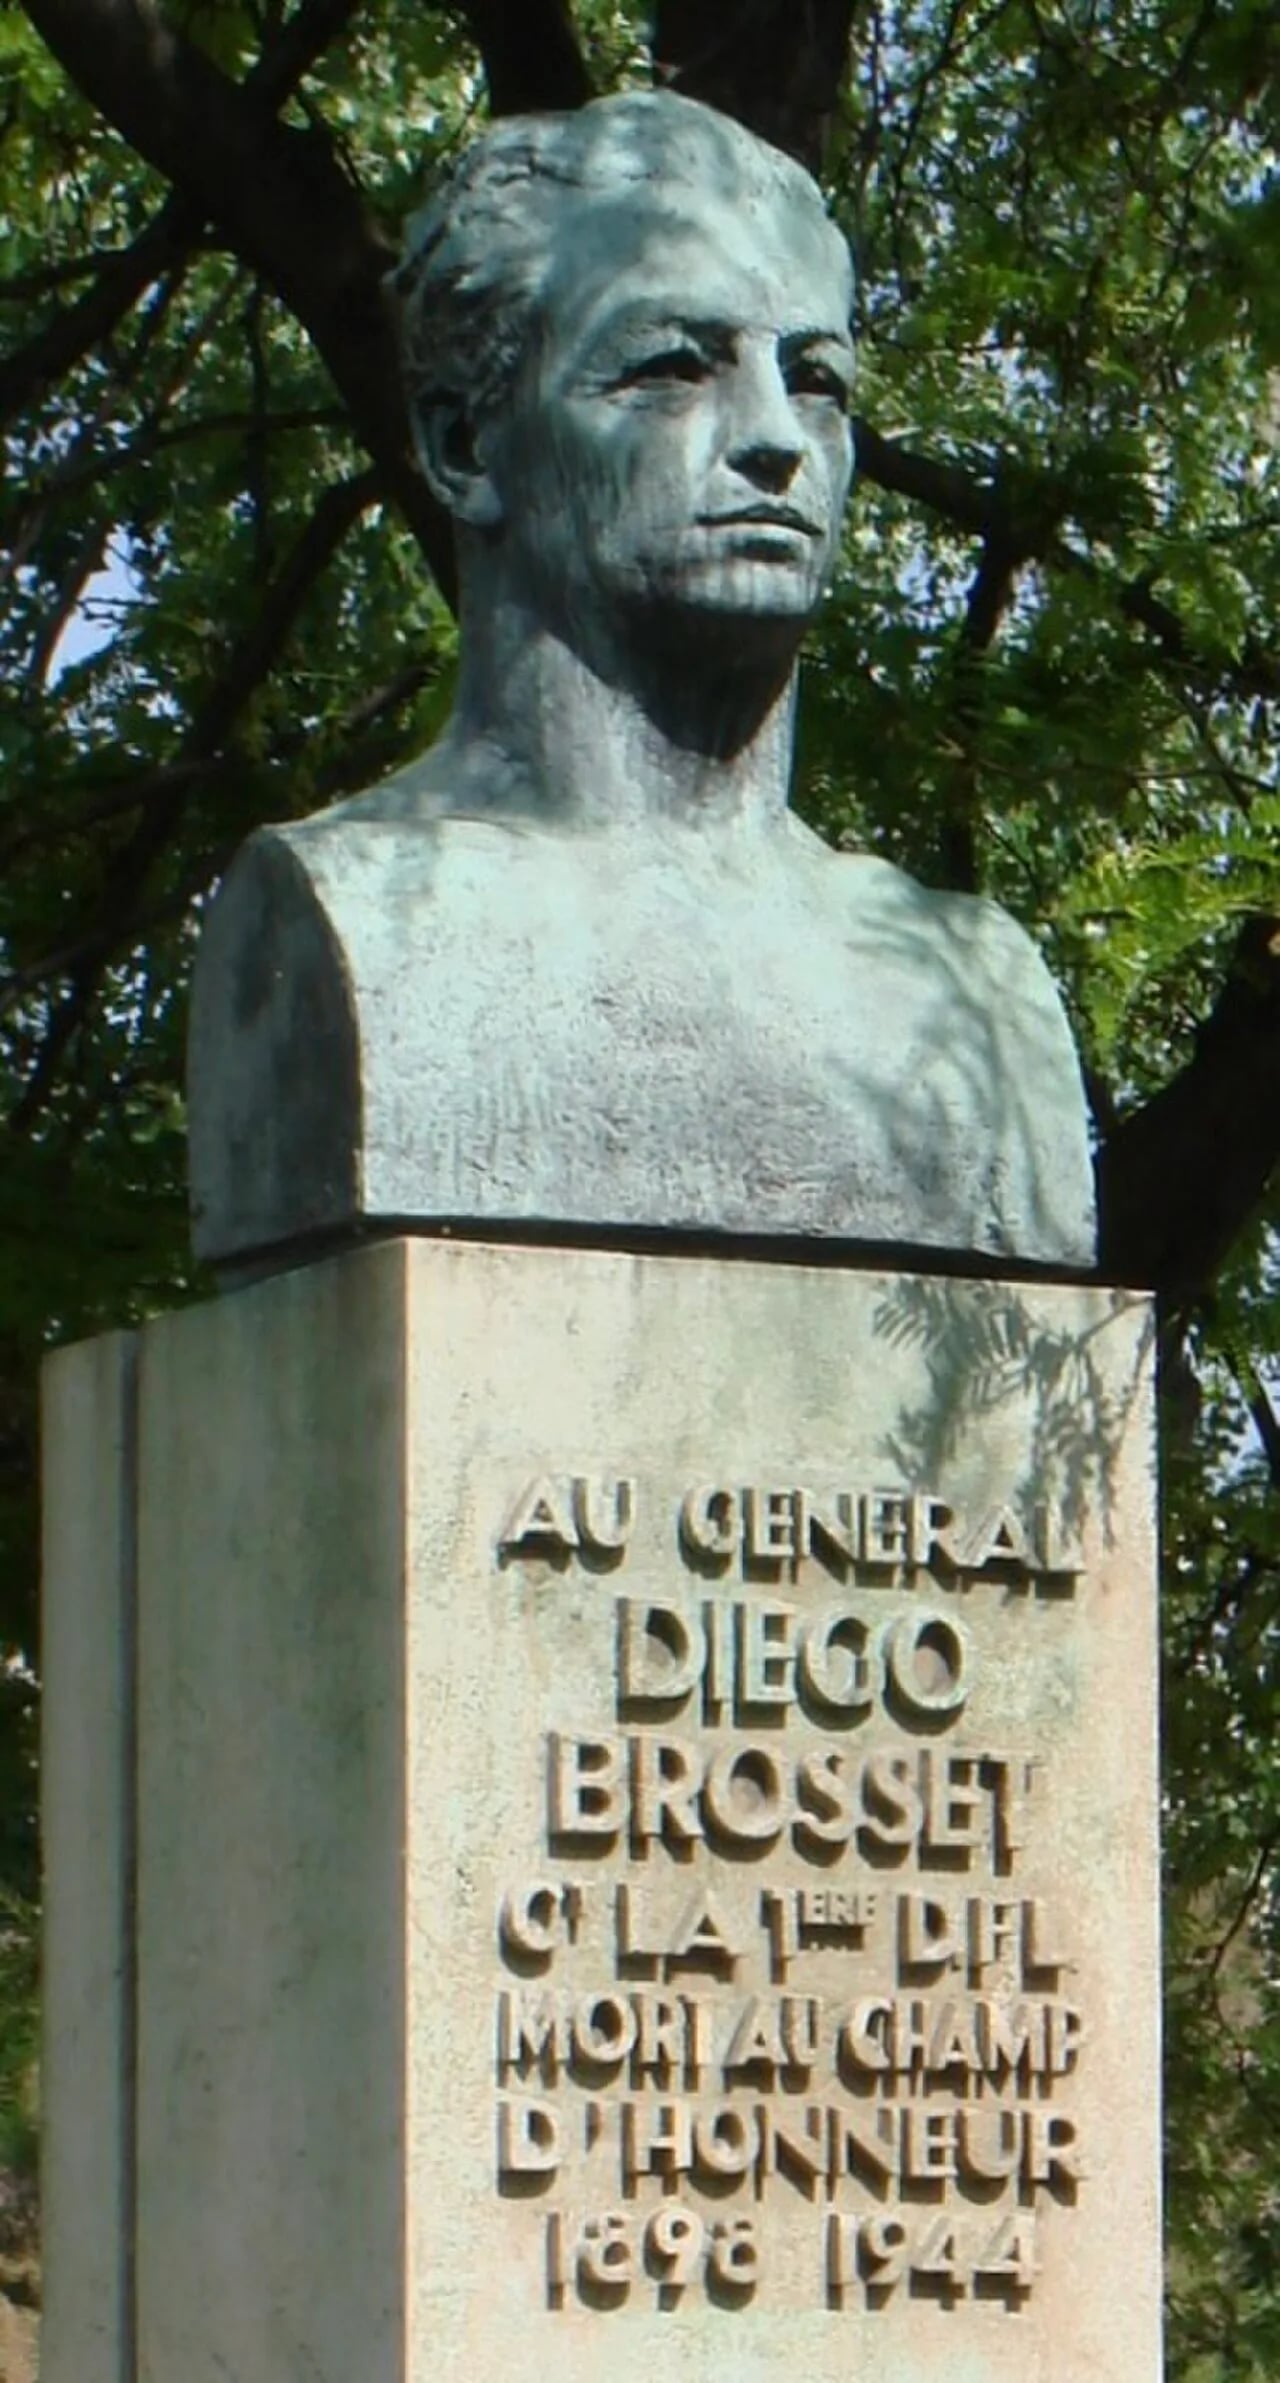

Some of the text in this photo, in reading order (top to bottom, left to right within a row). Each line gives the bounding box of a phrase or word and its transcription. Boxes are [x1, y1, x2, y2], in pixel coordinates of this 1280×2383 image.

[501, 1474, 1086, 1588] AU GENERAL
[614, 1597, 972, 1726] DIEGO
[545, 1729, 1044, 1862] BROSSET
[613, 1881, 746, 1975] LA
[498, 1989, 1091, 2092] MORT AU CHAMP
[826, 2210, 1042, 2303] 1944
